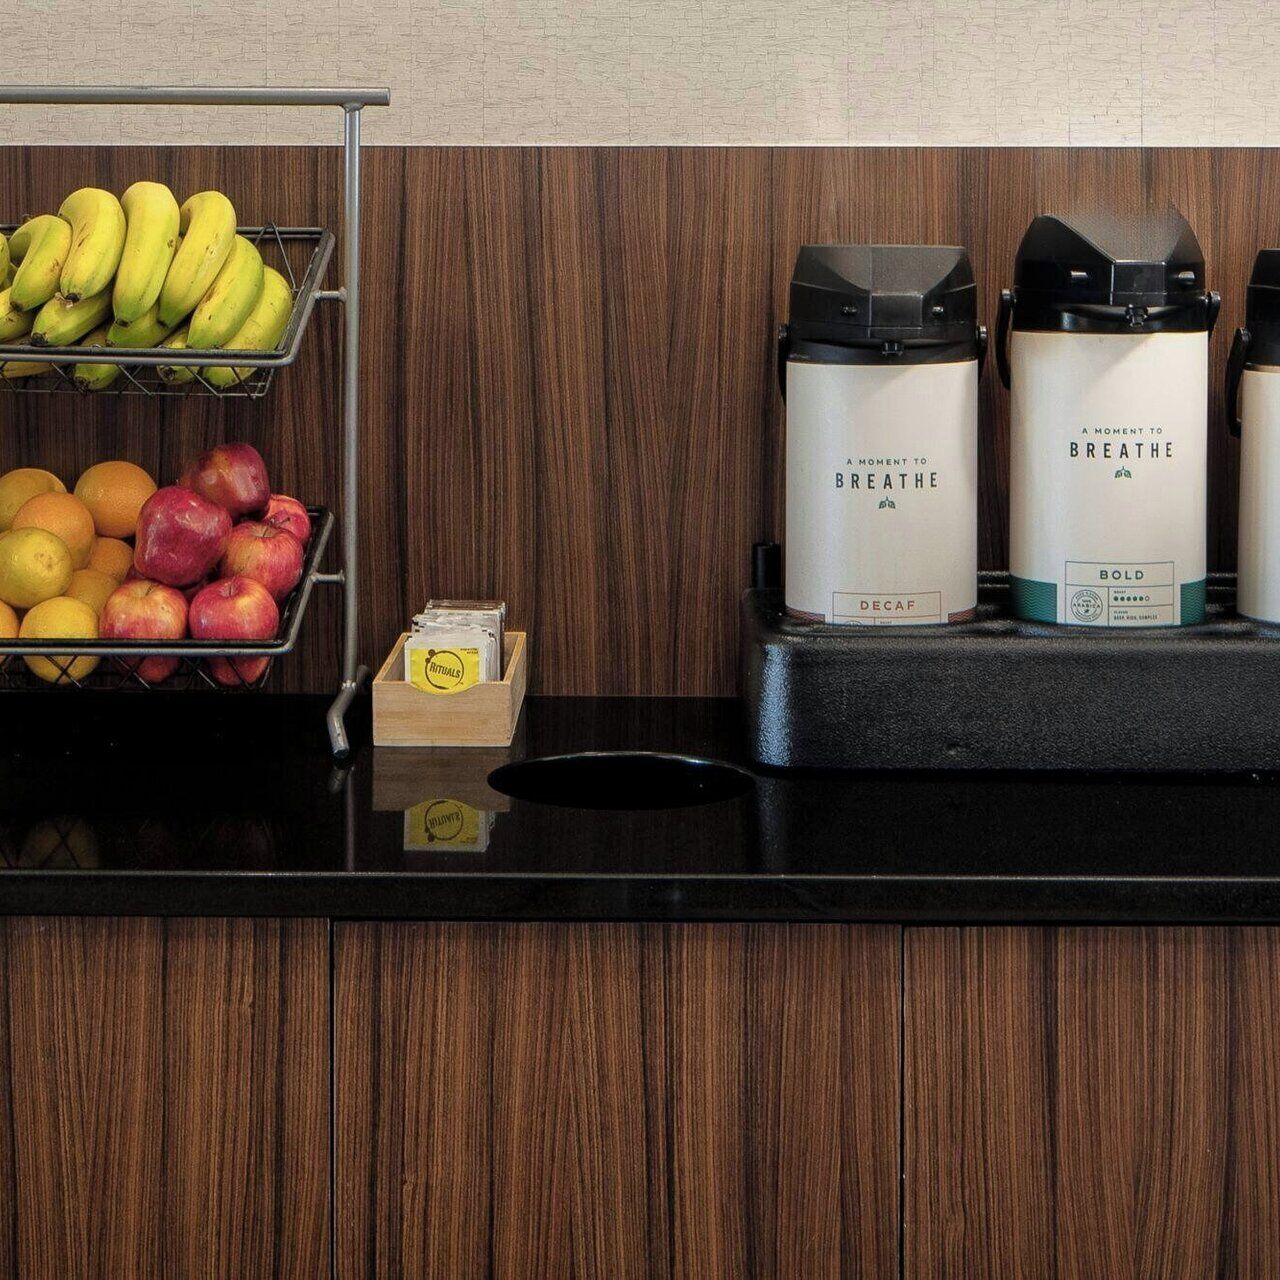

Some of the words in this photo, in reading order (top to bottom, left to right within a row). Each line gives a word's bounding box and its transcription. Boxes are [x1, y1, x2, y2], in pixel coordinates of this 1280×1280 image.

[1082, 427, 1089, 435] A
[1094, 427, 1143, 435] MOMENT
[1150, 427, 1163, 435] TO
[1069, 441, 1173, 459] BREATHE
[858, 458, 907, 466] MOMENT
[914, 457, 927, 465] TO
[835, 472, 938, 489] BREATHE
[1099, 570, 1144, 580] BOLD
[860, 600, 915, 611] DECAF
[429, 661, 461, 679] RITUALS
